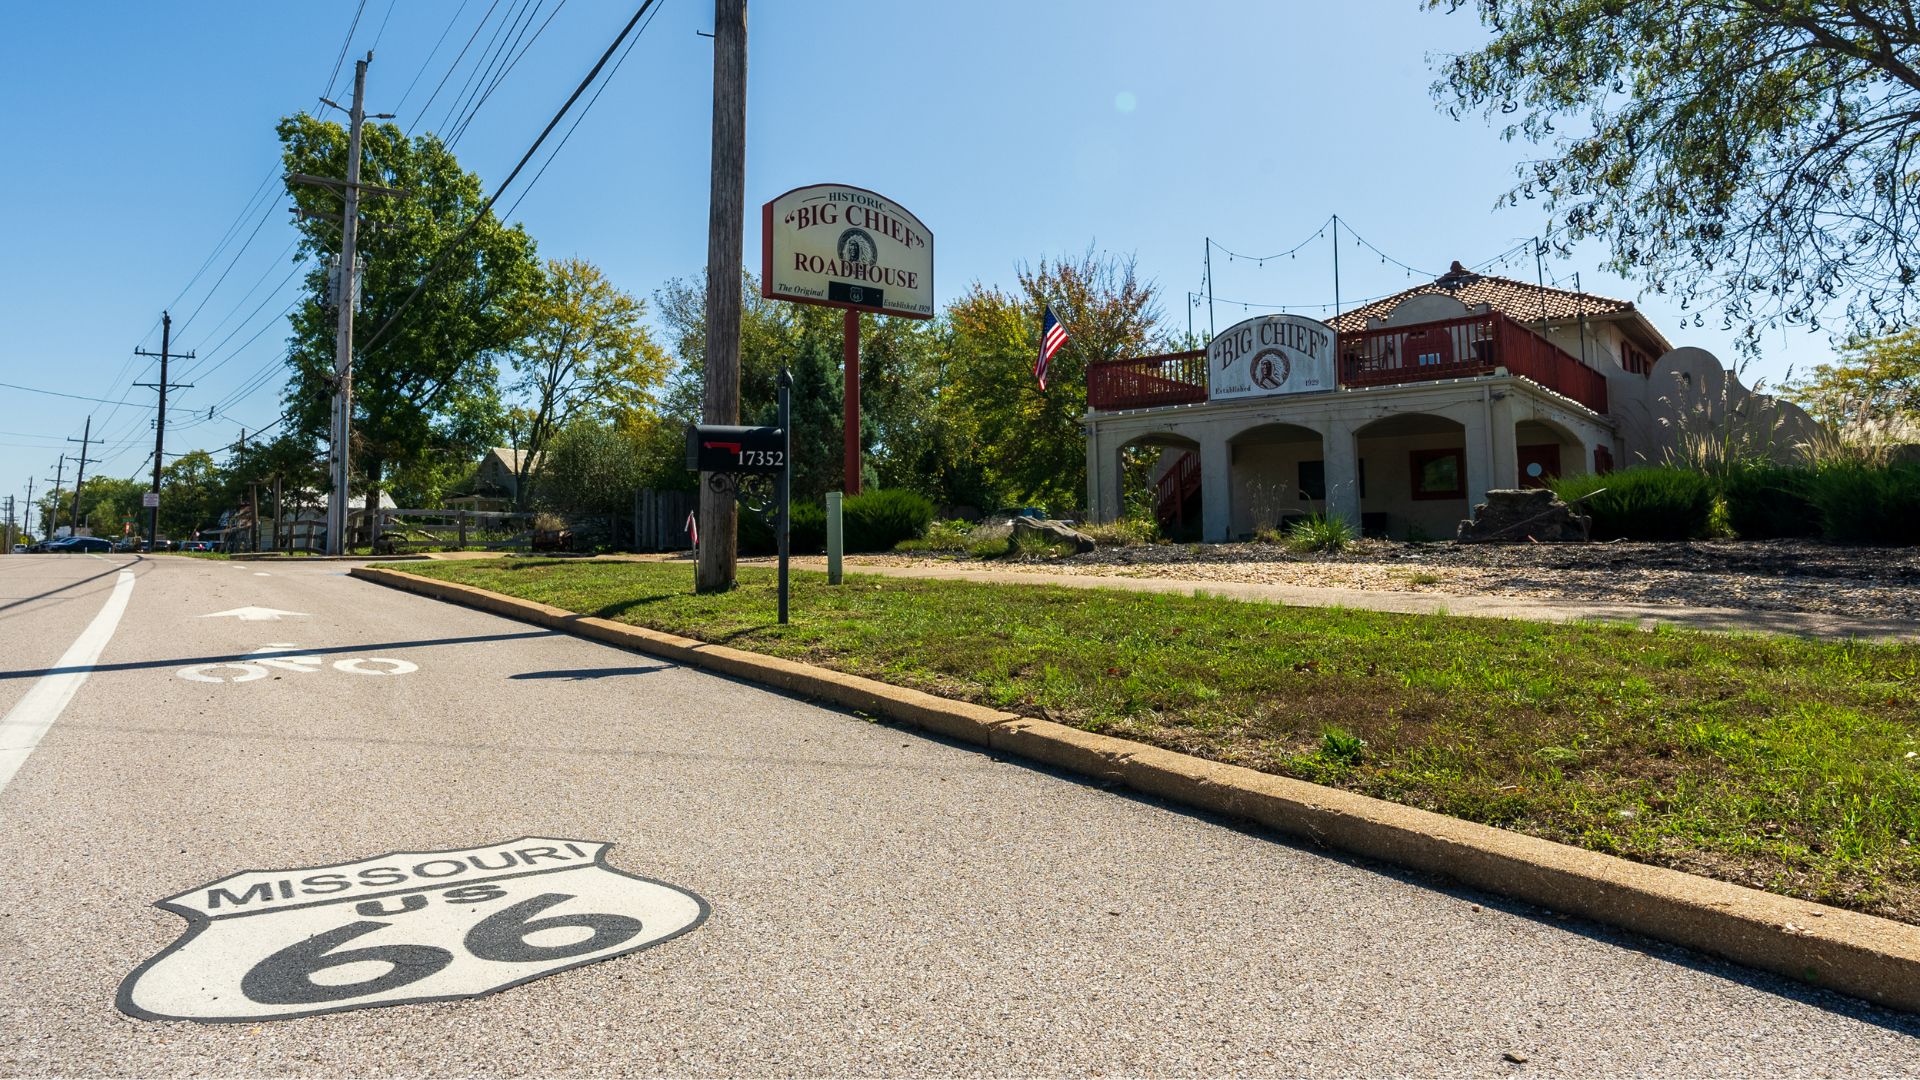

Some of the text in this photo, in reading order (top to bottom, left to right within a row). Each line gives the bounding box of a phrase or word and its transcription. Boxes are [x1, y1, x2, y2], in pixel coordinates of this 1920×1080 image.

[828, 192, 887, 212] HISTORIC
[794, 252, 918, 290] ROADHOUSE
[778, 283, 824, 298] The Original
[883, 299, 917, 311] Established
[1215, 384, 1251, 395] Established
[738, 450, 784, 466] 17352
[207, 843, 588, 909] MISSOURI
[355, 884, 508, 916] US
[241, 893, 643, 1005] 66
